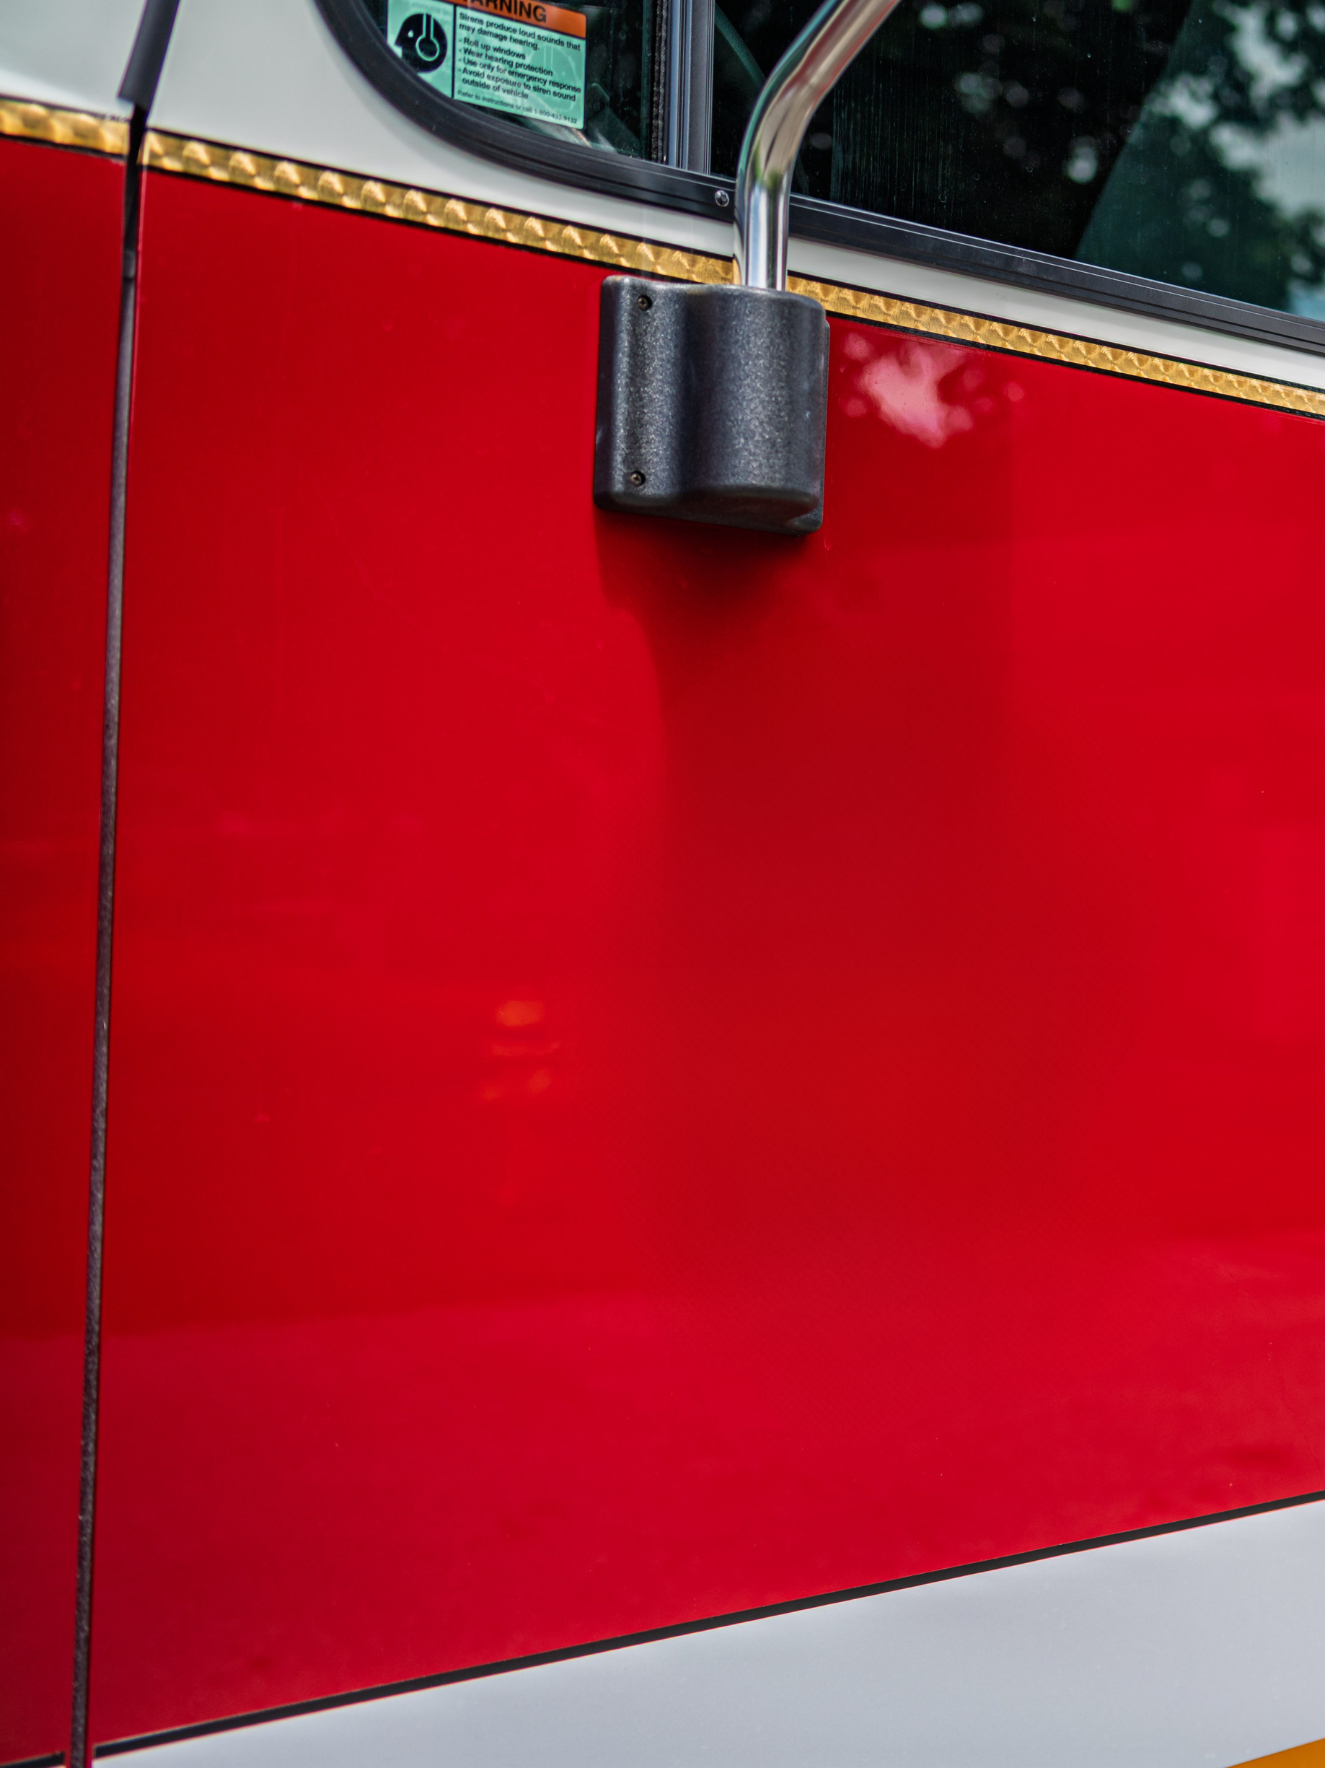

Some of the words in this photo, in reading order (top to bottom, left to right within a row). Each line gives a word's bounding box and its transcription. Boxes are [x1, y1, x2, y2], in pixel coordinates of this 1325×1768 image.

[459, 23, 475, 34] may
[477, 28, 508, 42] damage
[509, 35, 540, 51] hearing.
[460, 12, 484, 25] Sirens
[486, 21, 517, 34] produce
[519, 28, 536, 39] loud
[537, 34, 564, 47] sounds
[566, 41, 581, 51] that
[463, 37, 479, 47] Roll
[480, 42, 491, 51] up
[492, 46, 526, 60] windows
[463, 47, 483, 59] Wear
[485, 52, 514, 68] hearing
[515, 61, 553, 77] protection
[462, 67, 485, 79] Avoid
[486, 74, 522, 88] exposure
[523, 82, 532, 90] to
[532, 85, 551, 95] siren
[552, 91, 576, 102] sound
[462, 78, 491, 90] outside
[502, 87, 529, 100] vehicle
[463, 57, 478, 67] Use
[479, 62, 495, 73] only
[496, 65, 507, 74] for
[508, 70, 547, 86] emergency
[549, 80, 582, 93] response
[457, 90, 474, 98] Refer
[482, 97, 514, 108] instructions
